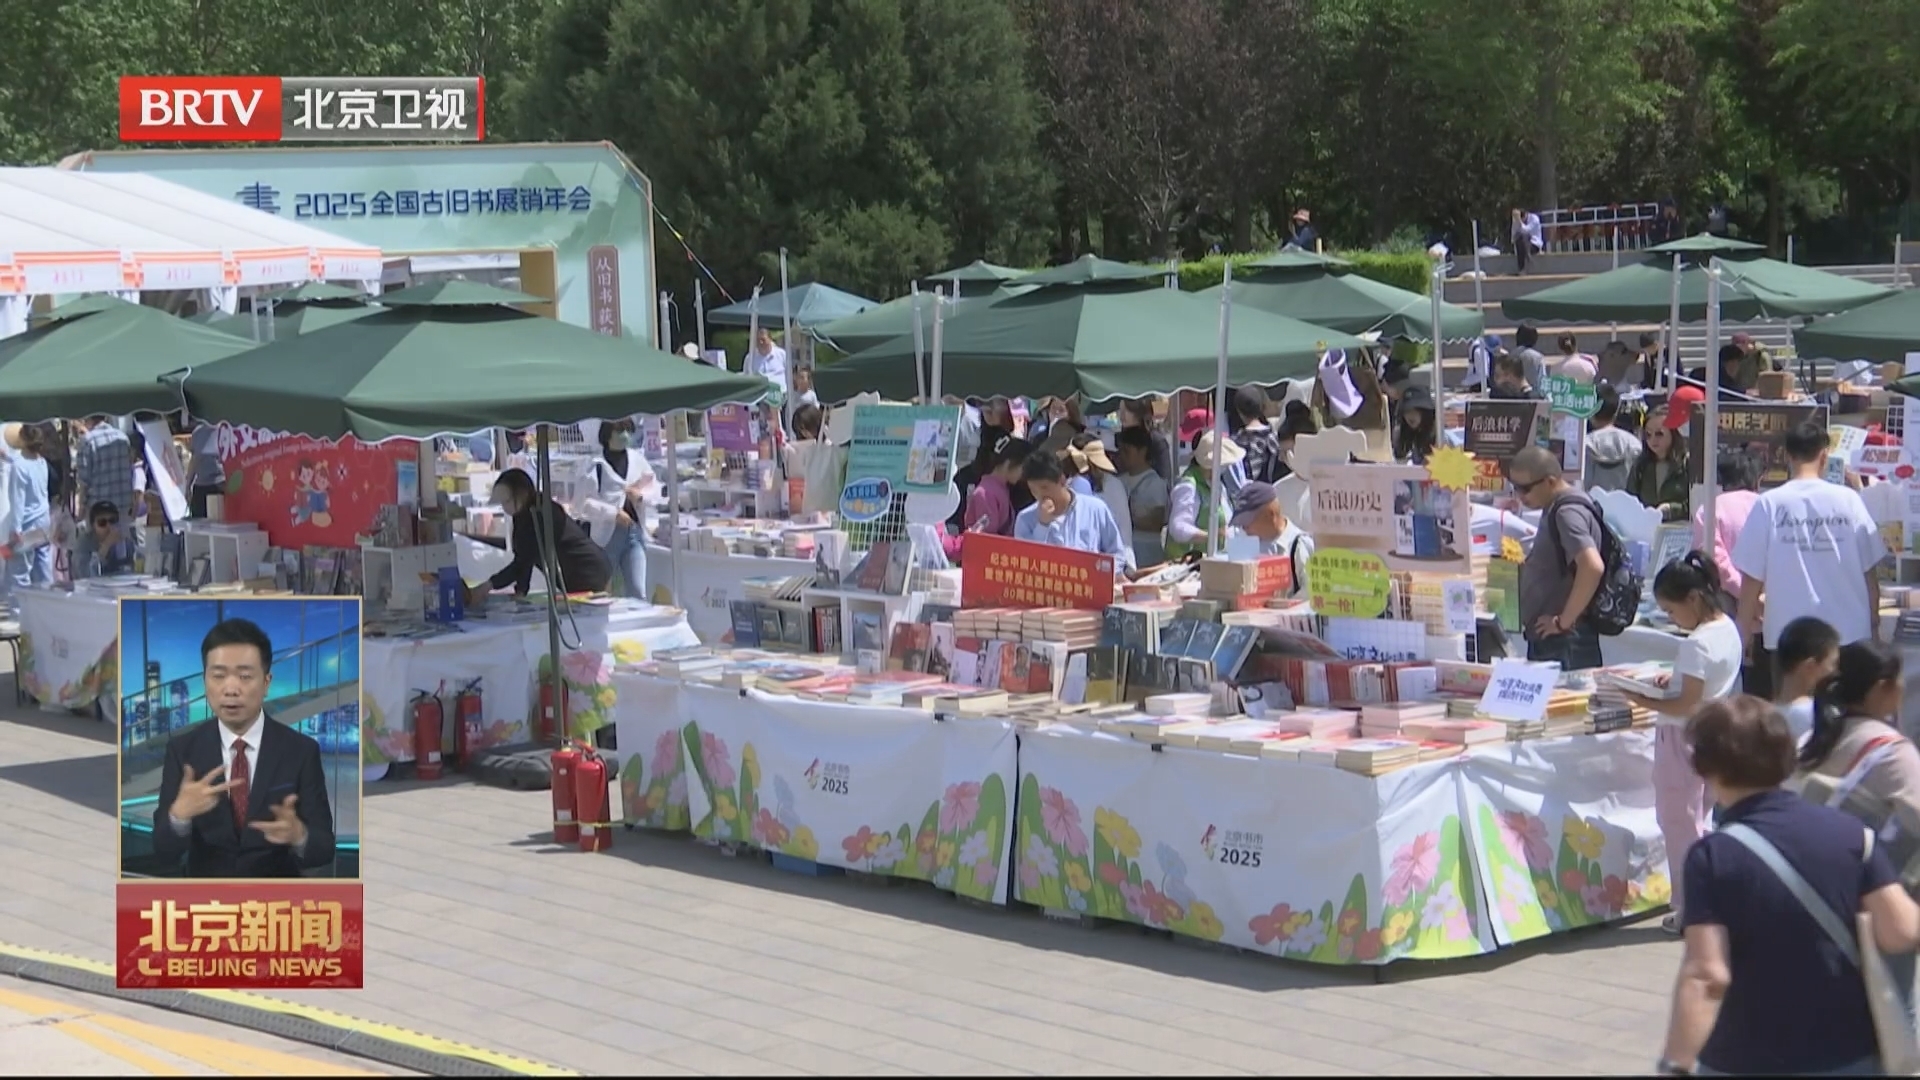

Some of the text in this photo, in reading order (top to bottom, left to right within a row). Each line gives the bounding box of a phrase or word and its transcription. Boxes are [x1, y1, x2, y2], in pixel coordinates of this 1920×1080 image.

[1317, 488, 1382, 513] 后浪历史
[821, 776, 849, 795] 2025
[1219, 847, 1262, 868] 2025
